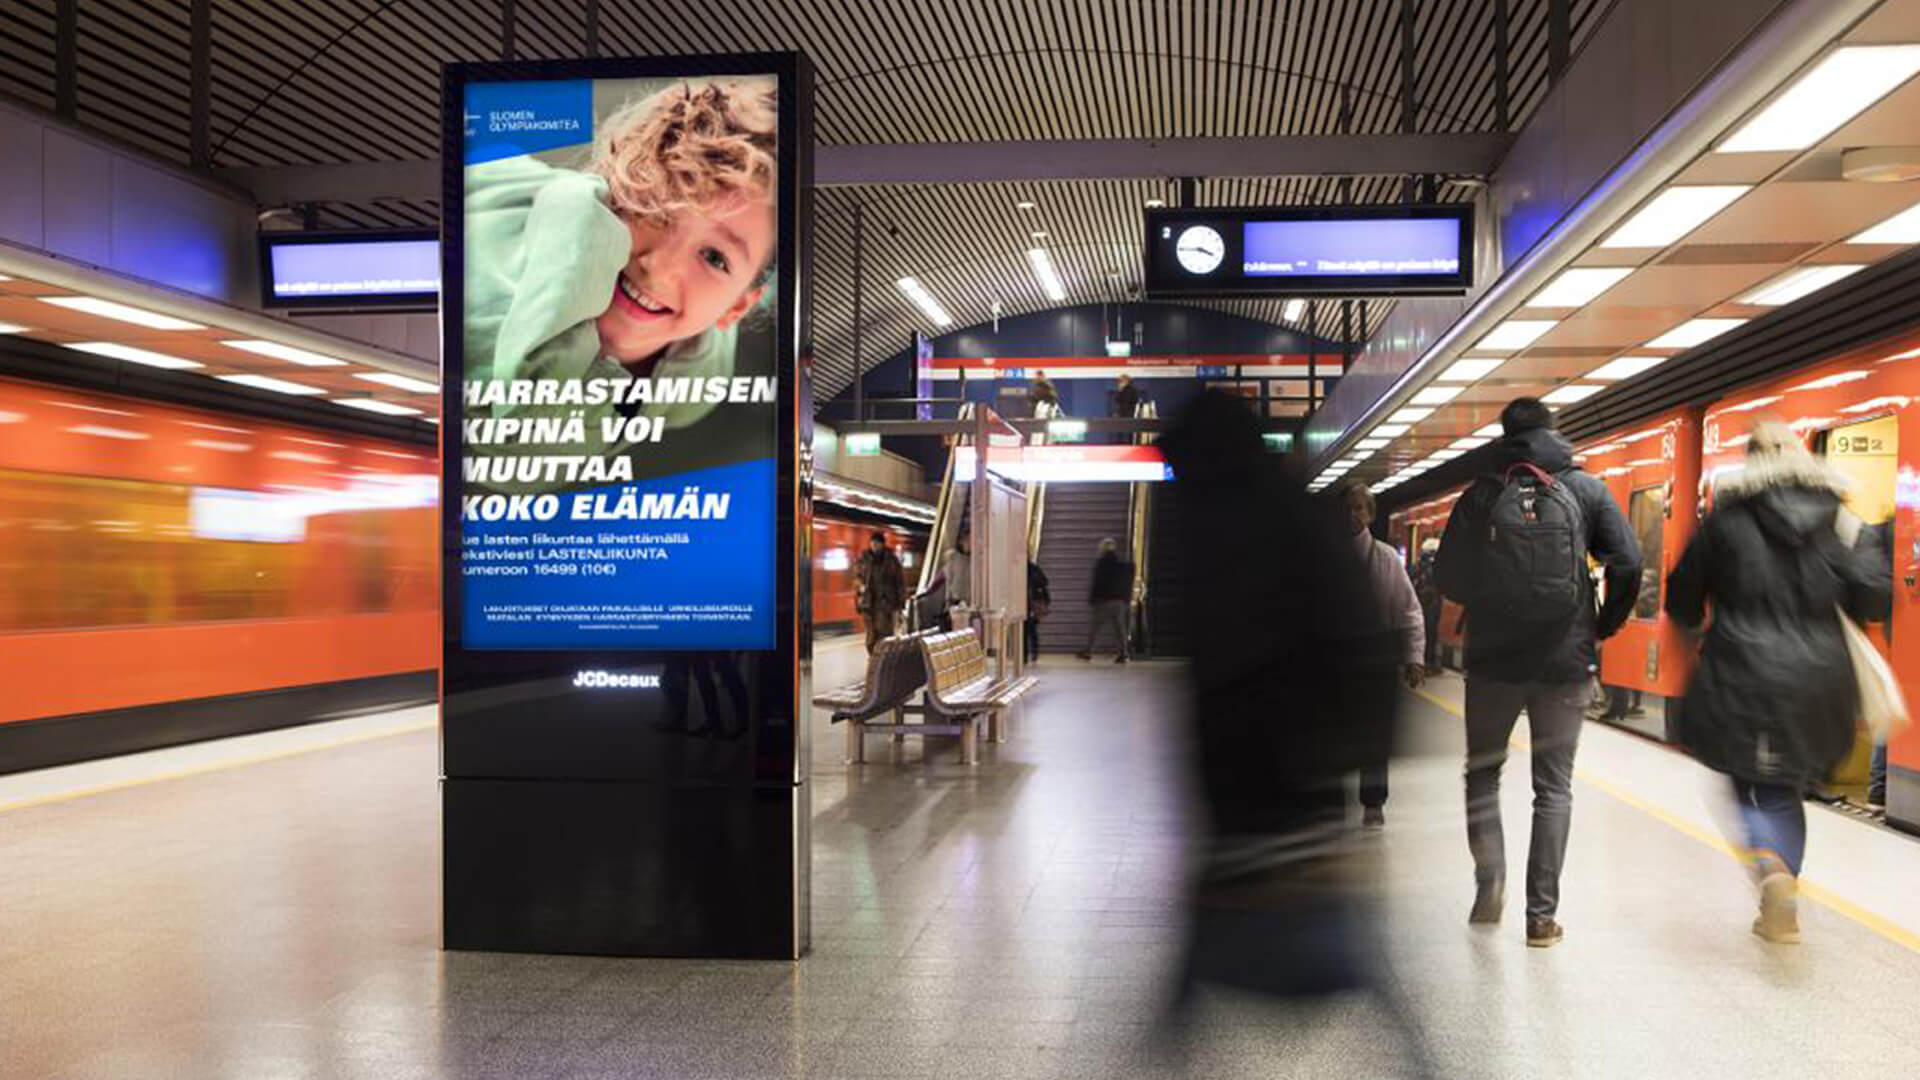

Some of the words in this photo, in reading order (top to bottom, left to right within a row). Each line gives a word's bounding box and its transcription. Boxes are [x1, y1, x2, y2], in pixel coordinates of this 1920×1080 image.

[463, 376, 777, 406] HARRASTAMISEN
[461, 411, 586, 445] KIPINÄ
[601, 416, 665, 443] VOI
[461, 455, 634, 483] MUUTTAA
[461, 494, 560, 521] KOKO
[570, 486, 731, 520] ELÄMÄN
[462, 535, 480, 545] ue
[483, 533, 529, 545] lasten
[533, 532, 594, 545] liikuntaa
[598, 532, 690, 544] lähettämällä
[462, 548, 535, 560] ekstiviesti
[539, 548, 669, 560] LASTENLIIKUNTA
[462, 564, 529, 576] umeroon
[534, 563, 578, 576] 16499
[582, 563, 617, 577] (10€)
[573, 670, 660, 688] JCDecaux
